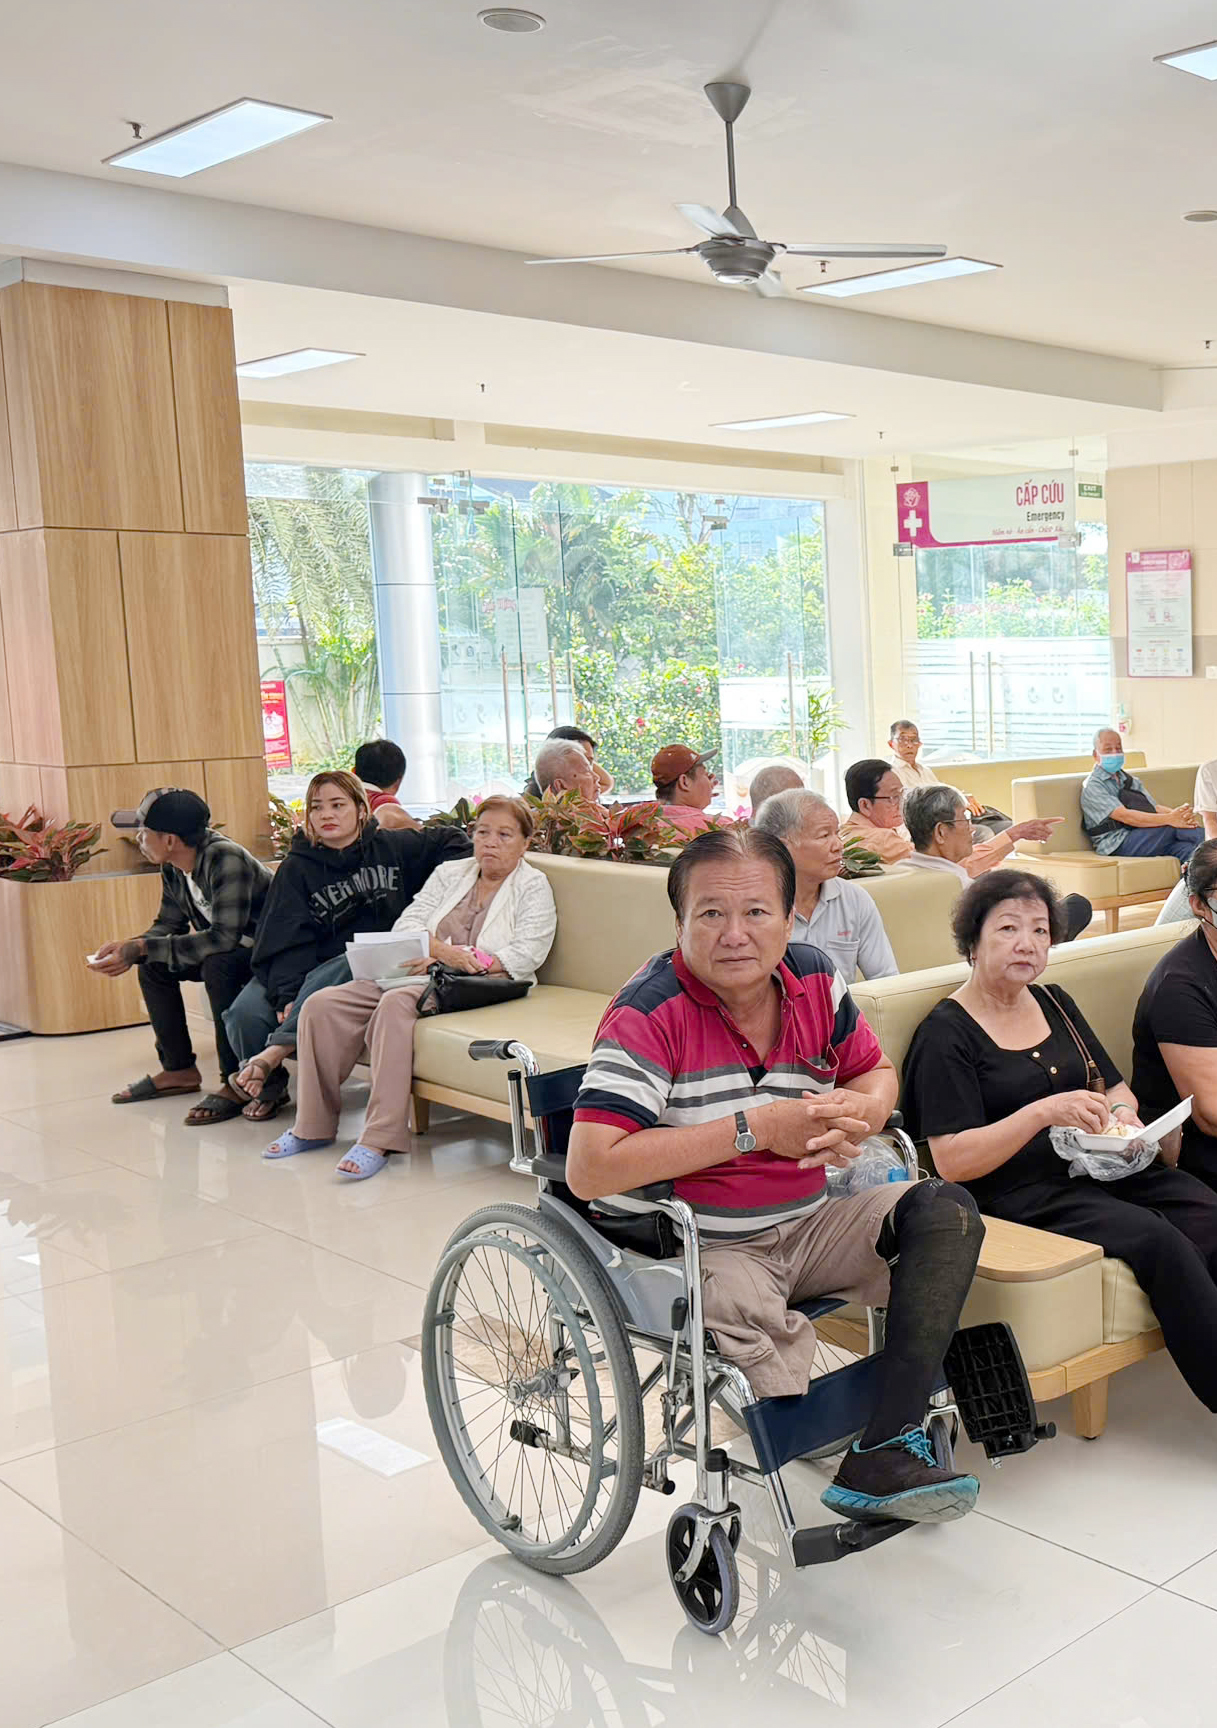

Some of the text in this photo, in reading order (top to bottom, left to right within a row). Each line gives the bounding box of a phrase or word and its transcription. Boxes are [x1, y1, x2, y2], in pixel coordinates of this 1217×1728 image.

[1016, 479, 1064, 506] CẤP CỨU
[1026, 511, 1065, 522] Emergency
